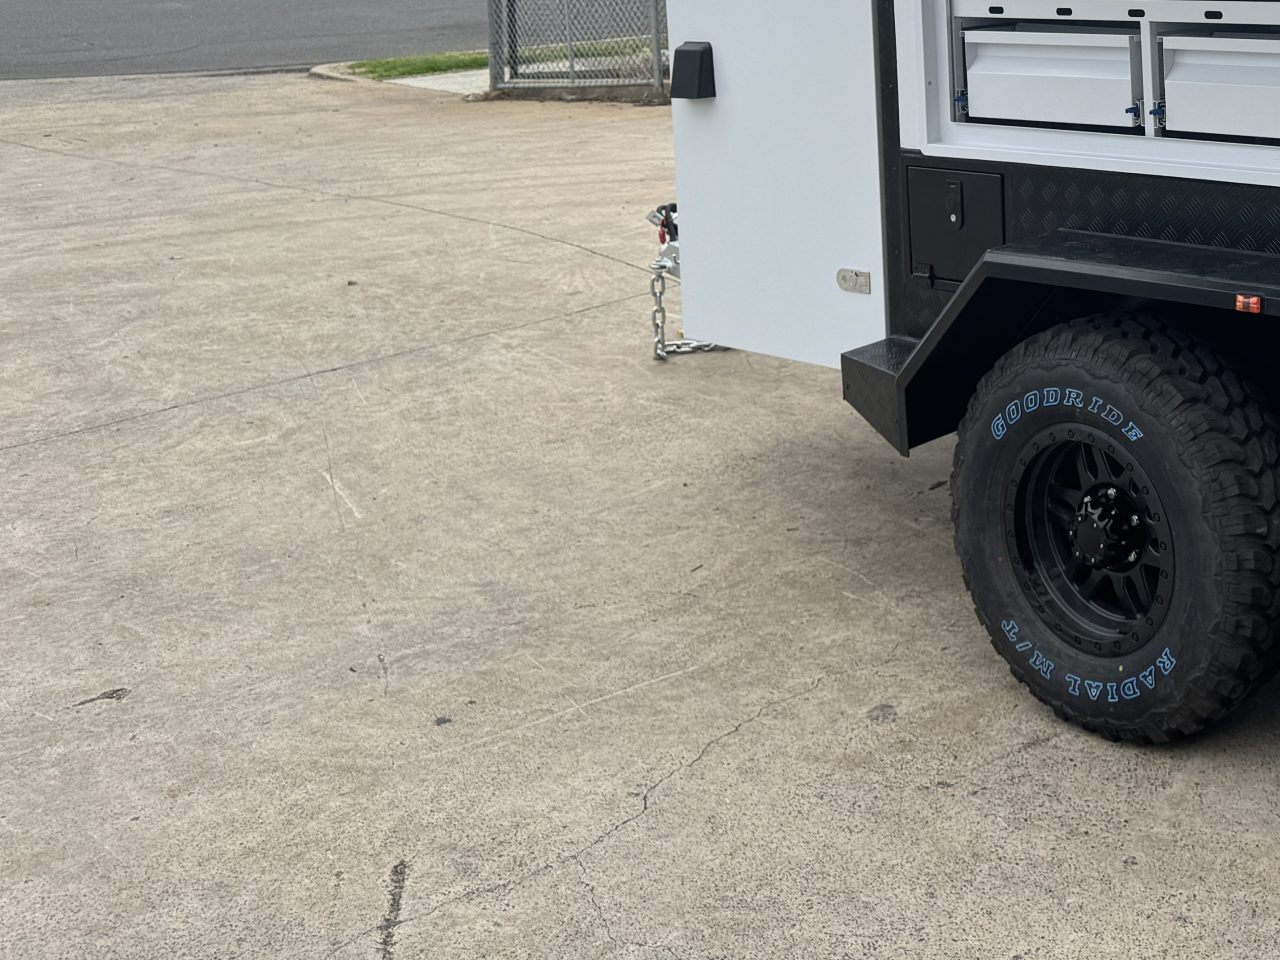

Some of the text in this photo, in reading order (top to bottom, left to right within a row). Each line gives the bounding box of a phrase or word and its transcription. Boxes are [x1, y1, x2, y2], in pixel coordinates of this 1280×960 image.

[991, 387, 1144, 440] GOODRIDE
[1001, 619, 1177, 702] RADIAL M/T
